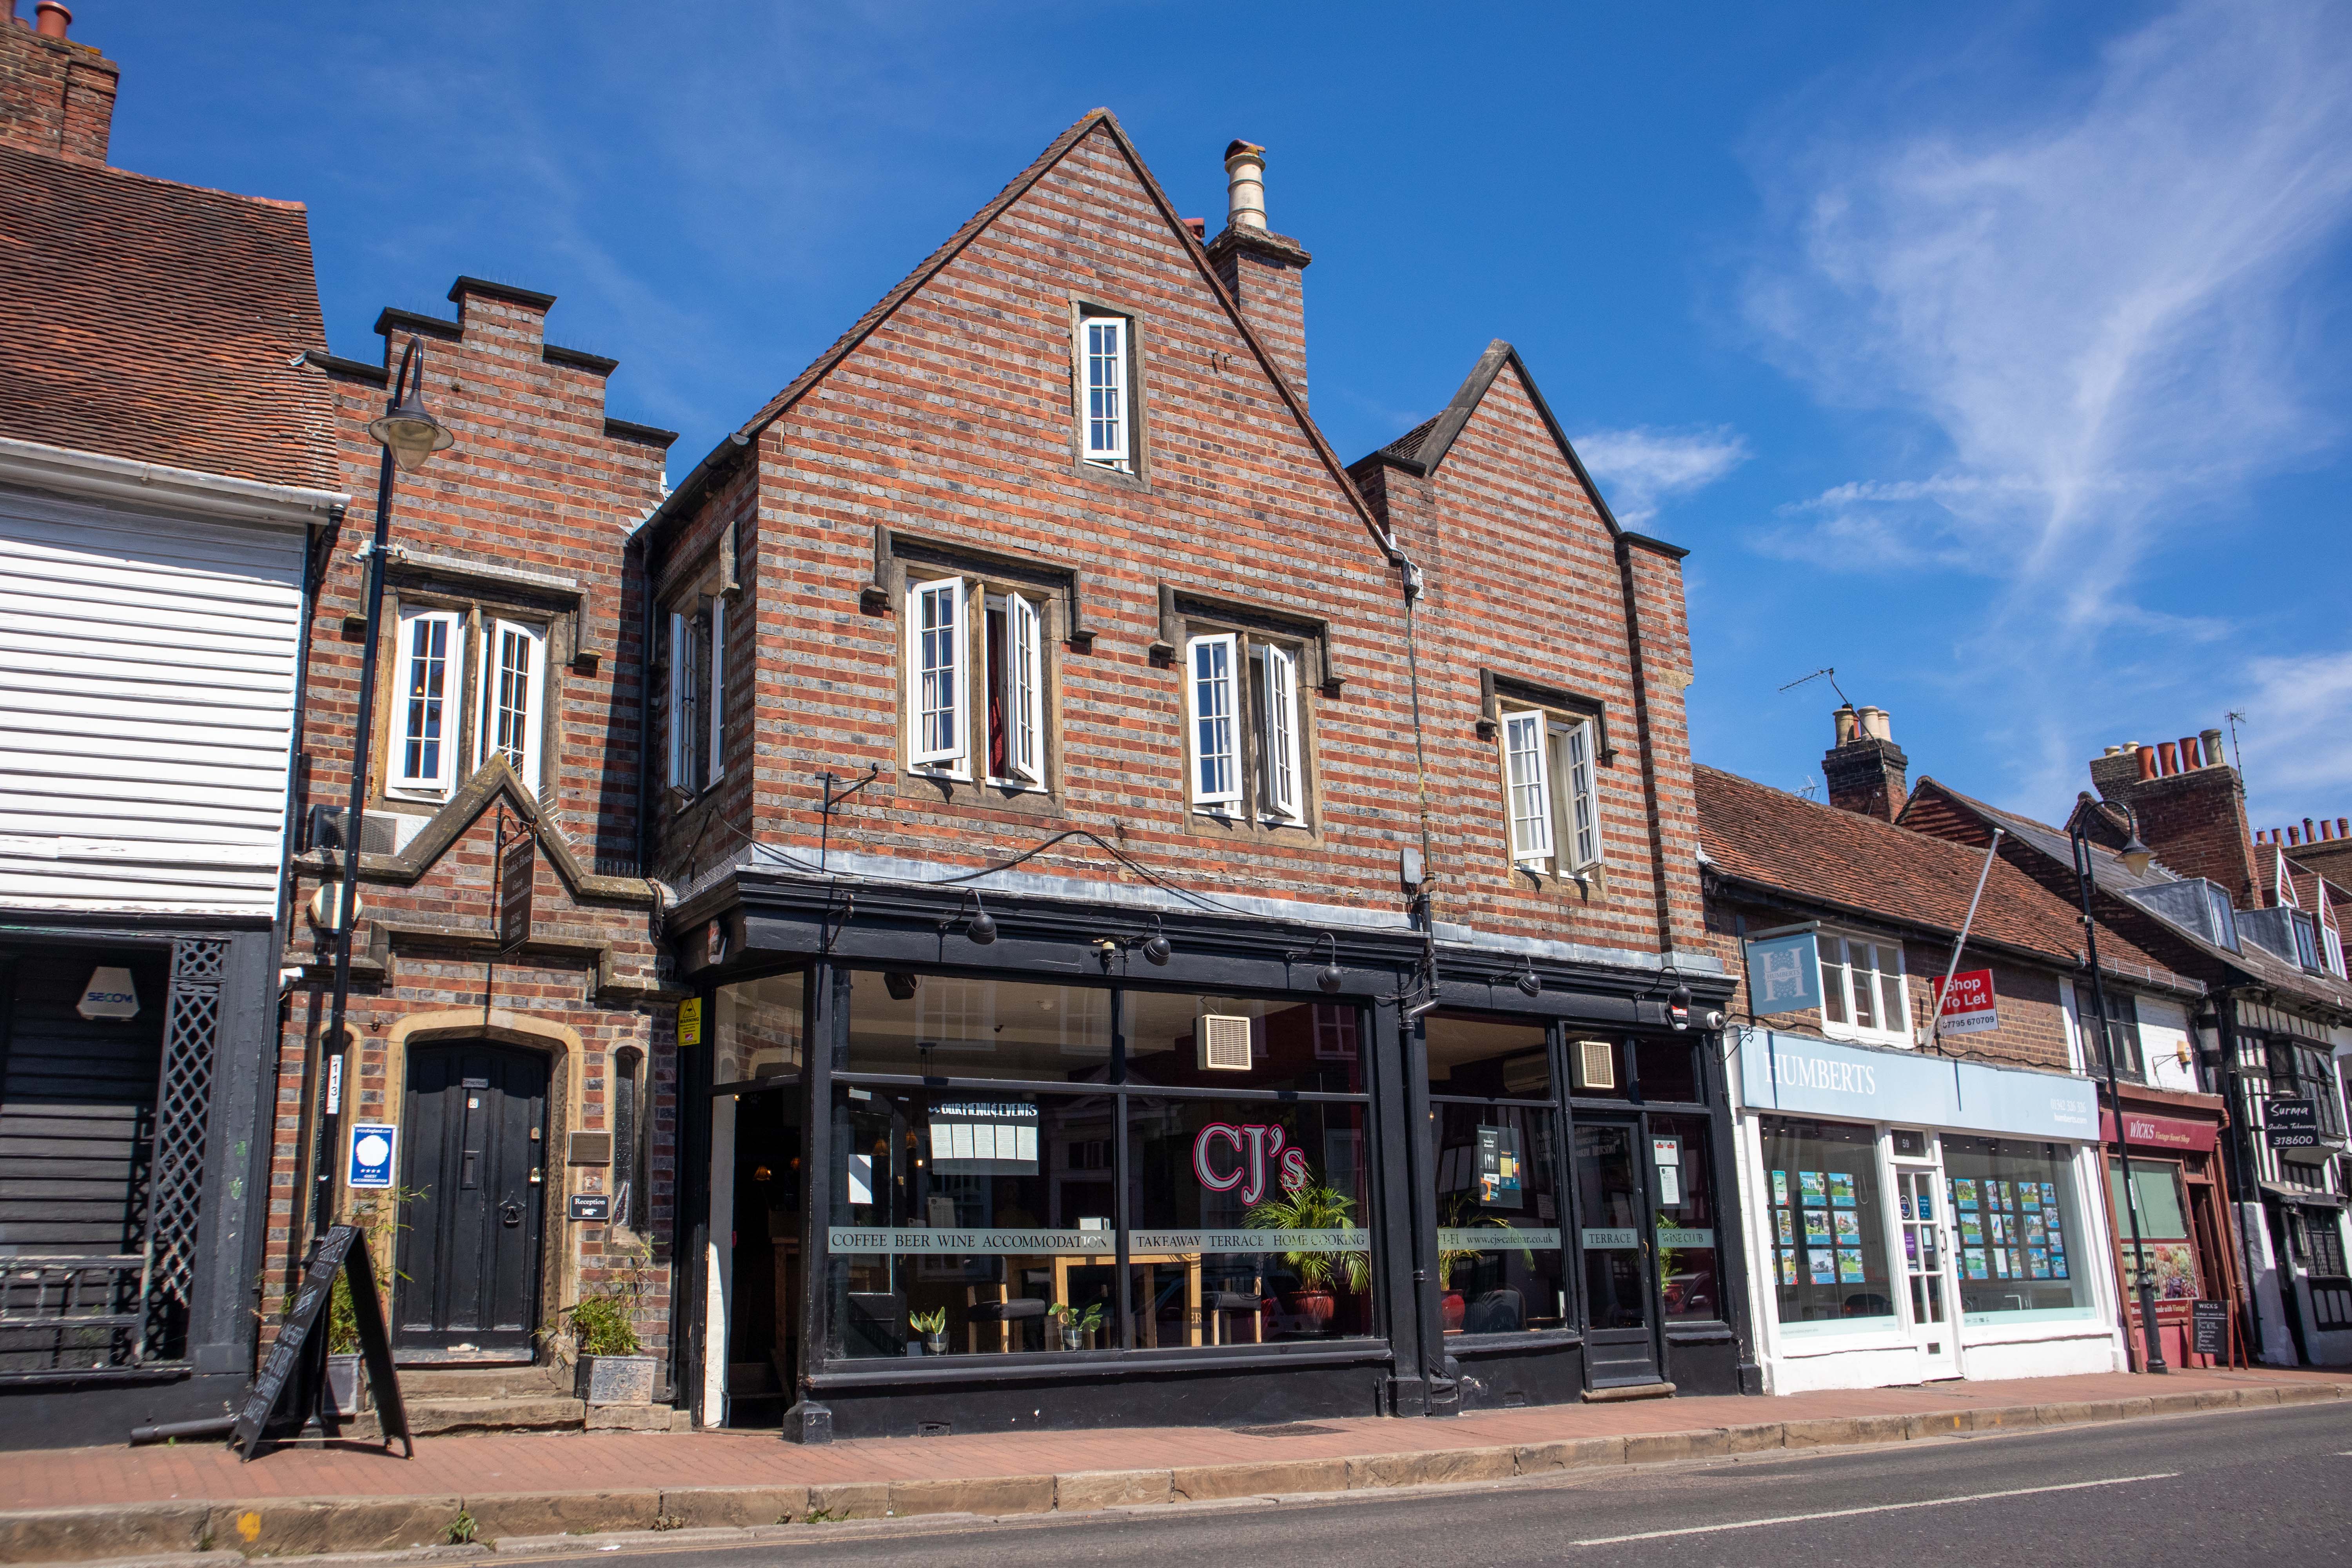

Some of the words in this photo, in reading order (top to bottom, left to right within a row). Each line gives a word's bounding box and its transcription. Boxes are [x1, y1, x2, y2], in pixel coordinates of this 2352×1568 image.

[519, 852, 533, 867] House
[1767, 969, 1800, 980] HUMBERTS
[1947, 978, 1981, 992] Shop
[87, 992, 134, 1004] SECOM
[1945, 996, 1960, 1009] To
[1964, 992, 1987, 1006] Let
[1967, 1016, 1994, 1026] 670709
[1763, 1051, 1876, 1095] HUMBERTS
[941, 1103, 963, 1114] OUR
[962, 1103, 991, 1116] MENU
[999, 1103, 1038, 1116] EVENTS
[2270, 1103, 2308, 1116] Surma
[2130, 1120, 2155, 1140] WICKS
[2155, 1131, 2170, 1142] Vintage
[2169, 1133, 2180, 1142] Sweet
[2180, 1134, 2190, 1144] Shop
[1902, 1139, 1910, 1148] 59
[2273, 1135, 2313, 1145] 318600
[1193, 1122, 1307, 1206] CJ's
[832, 1234, 887, 1247] COFFEE
[895, 1234, 931, 1247] BEER
[936, 1235, 975, 1247] WINE
[982, 1235, 1107, 1248] ACCOMMODATION
[1136, 1236, 1201, 1247] TAKEAWAY
[1209, 1235, 1265, 1247] TERRACE
[1273, 1235, 1308, 1246] HOME
[1310, 1234, 1365, 1246] COOKING
[1466, 1233, 1554, 1246] www.cjs-cafebar.co.uk
[1588, 1233, 1632, 1243] TERRACE
[1662, 1233, 1682, 1243] WINE
[1684, 1233, 1704, 1243] CLUB
